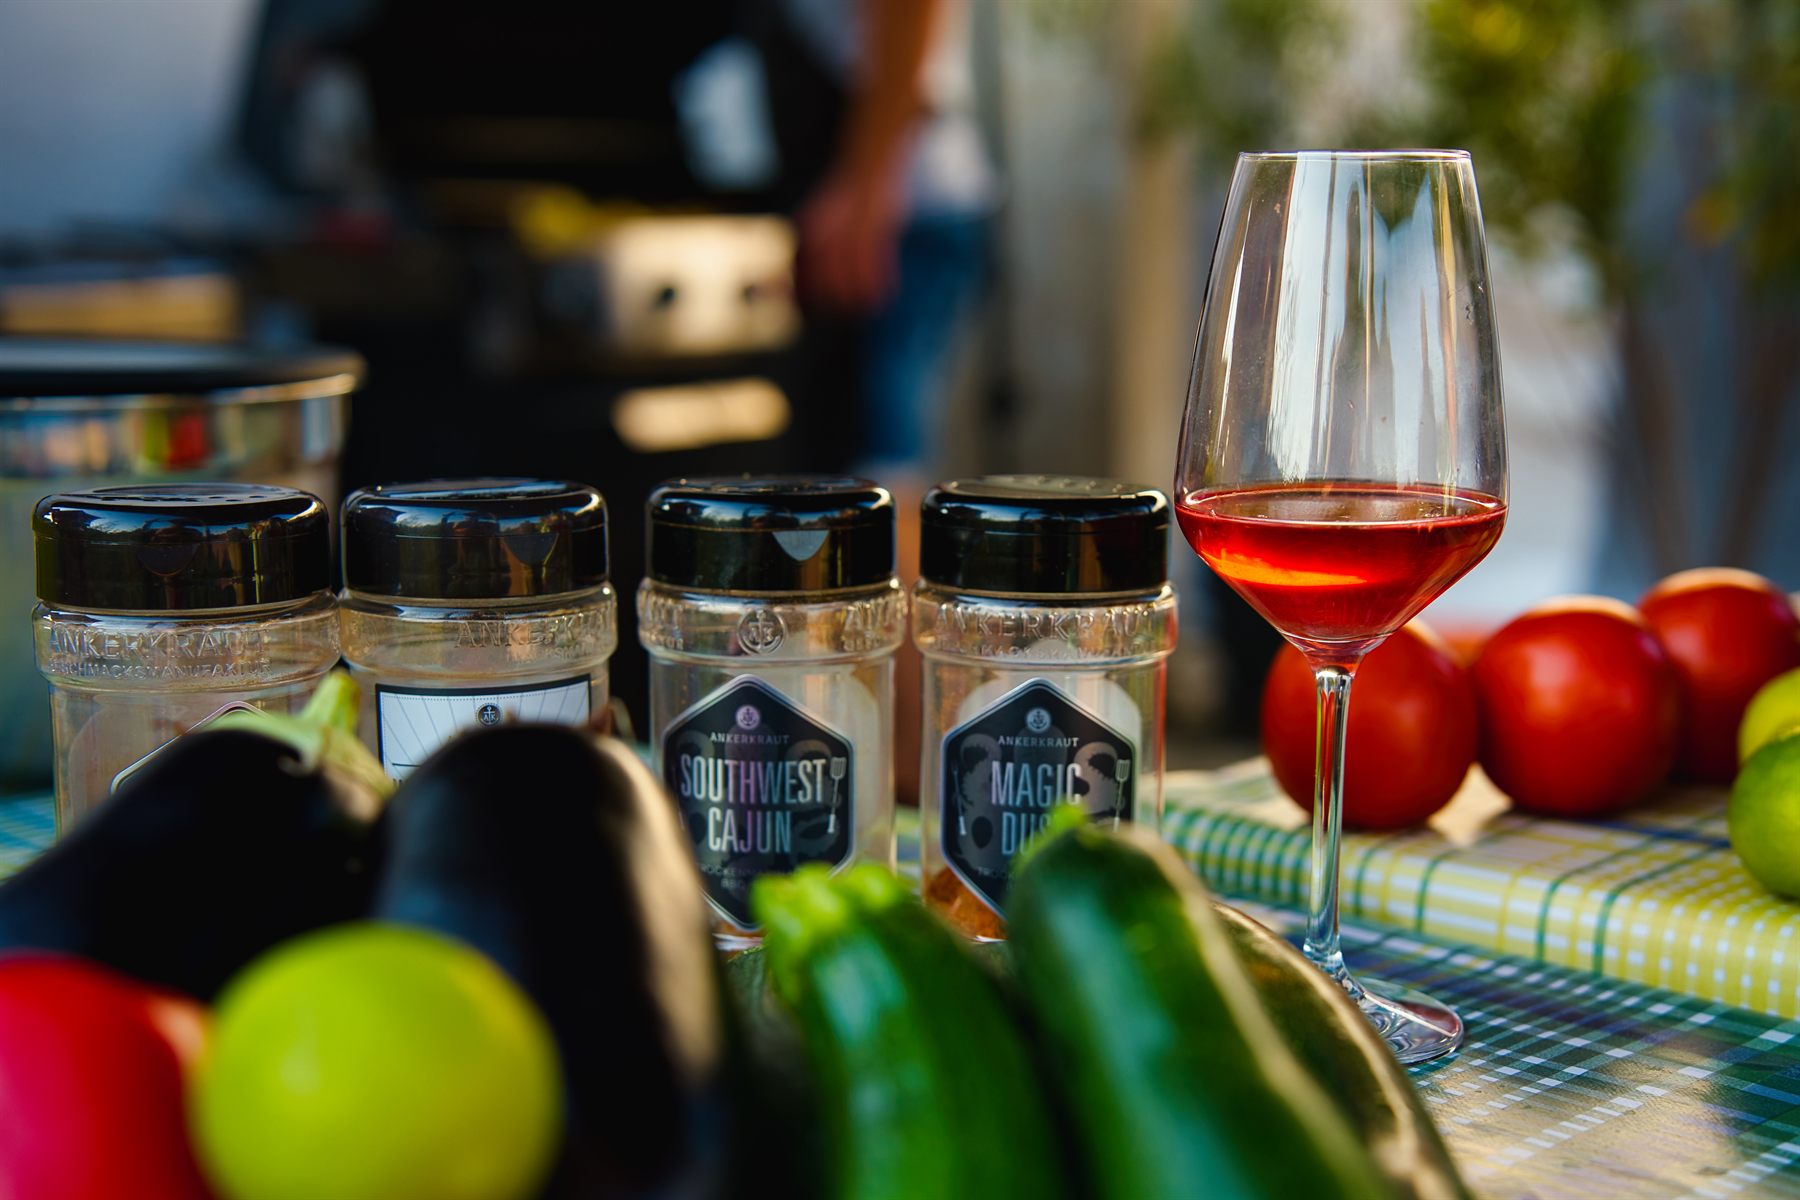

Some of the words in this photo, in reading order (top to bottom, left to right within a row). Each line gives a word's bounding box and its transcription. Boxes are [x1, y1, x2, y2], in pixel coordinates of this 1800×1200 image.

[49, 622, 268, 658] ANKERKRAUT
[709, 731, 790, 746] ANKERKRAUT
[997, 735, 1080, 748] ANKERKRAUT
[680, 753, 827, 805] SOUTHWEST
[991, 760, 1083, 808] MAGIC
[707, 806, 791, 854] CAJUN
